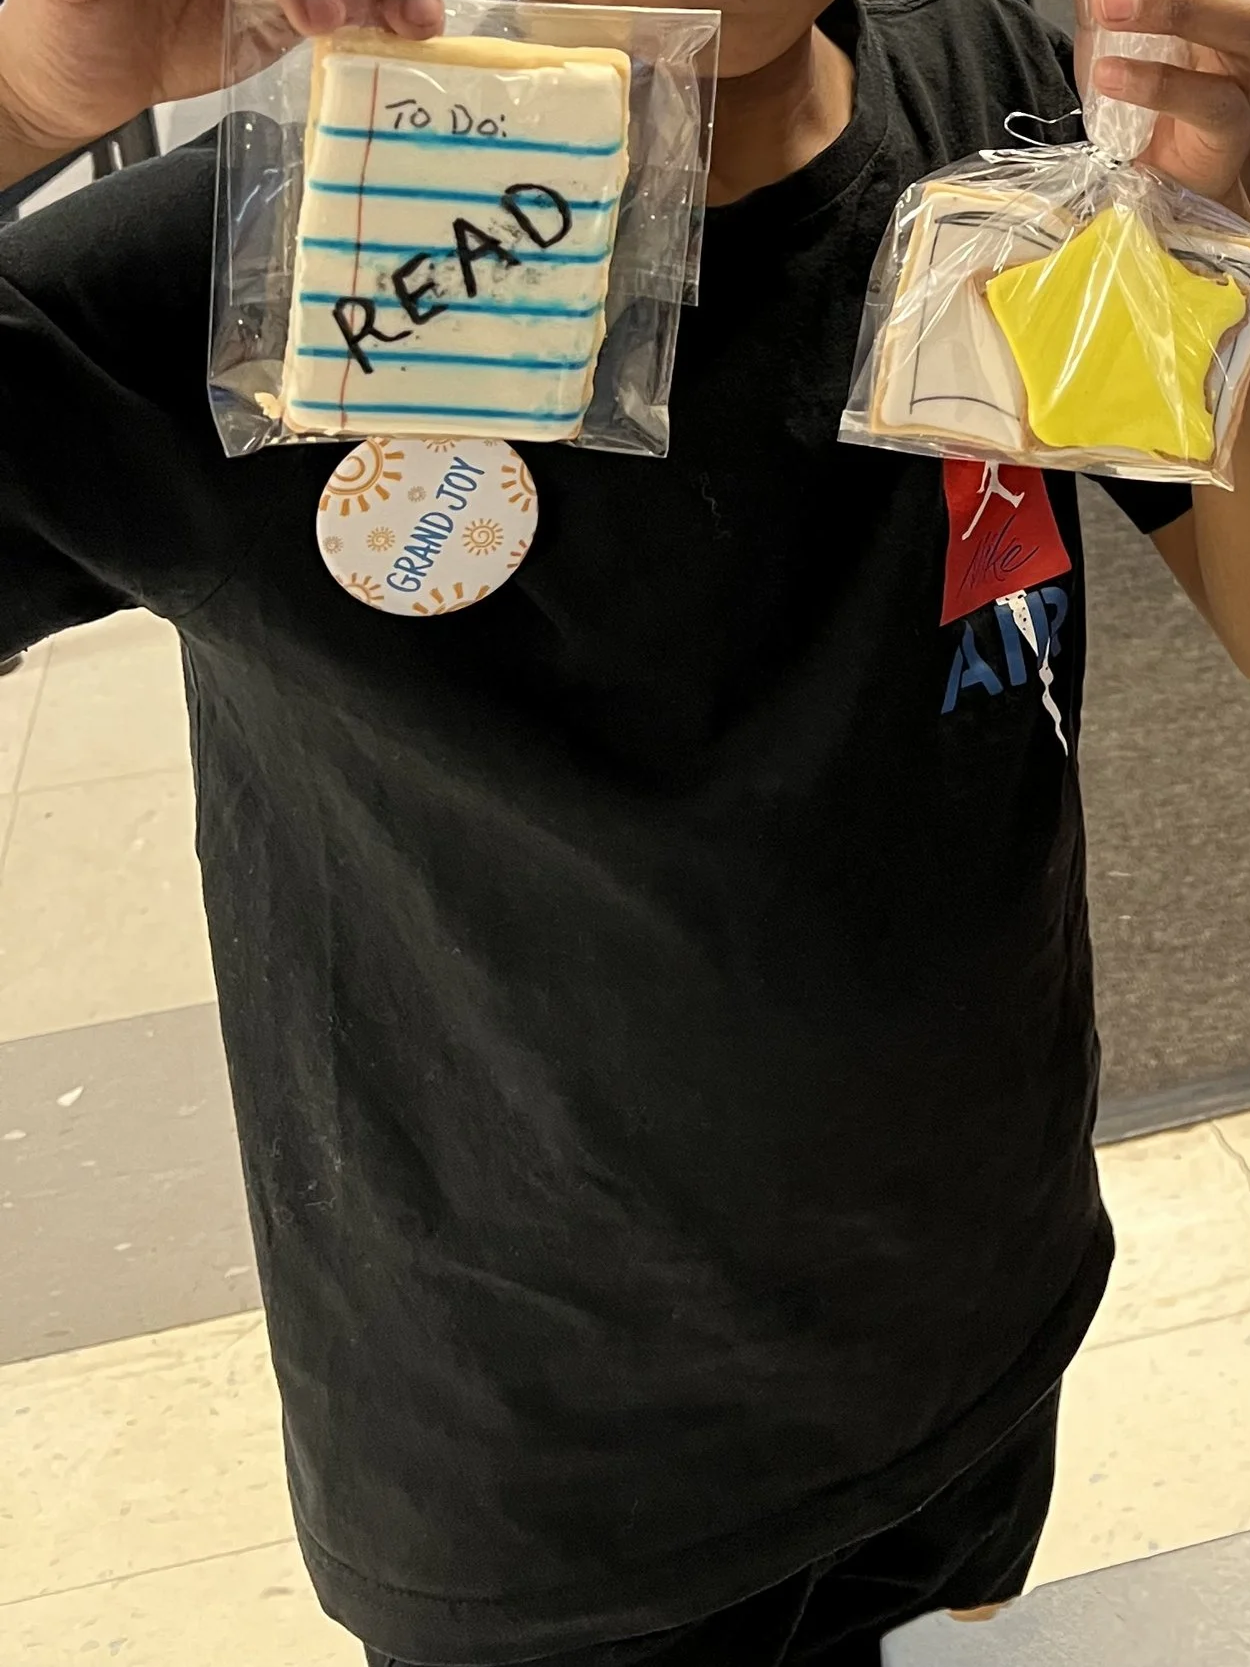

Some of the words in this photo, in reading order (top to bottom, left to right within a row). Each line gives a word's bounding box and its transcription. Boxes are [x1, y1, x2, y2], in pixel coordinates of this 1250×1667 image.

[332, 182, 573, 375] READ
[386, 511, 455, 594] GRAND
[435, 455, 486, 511] JOY
